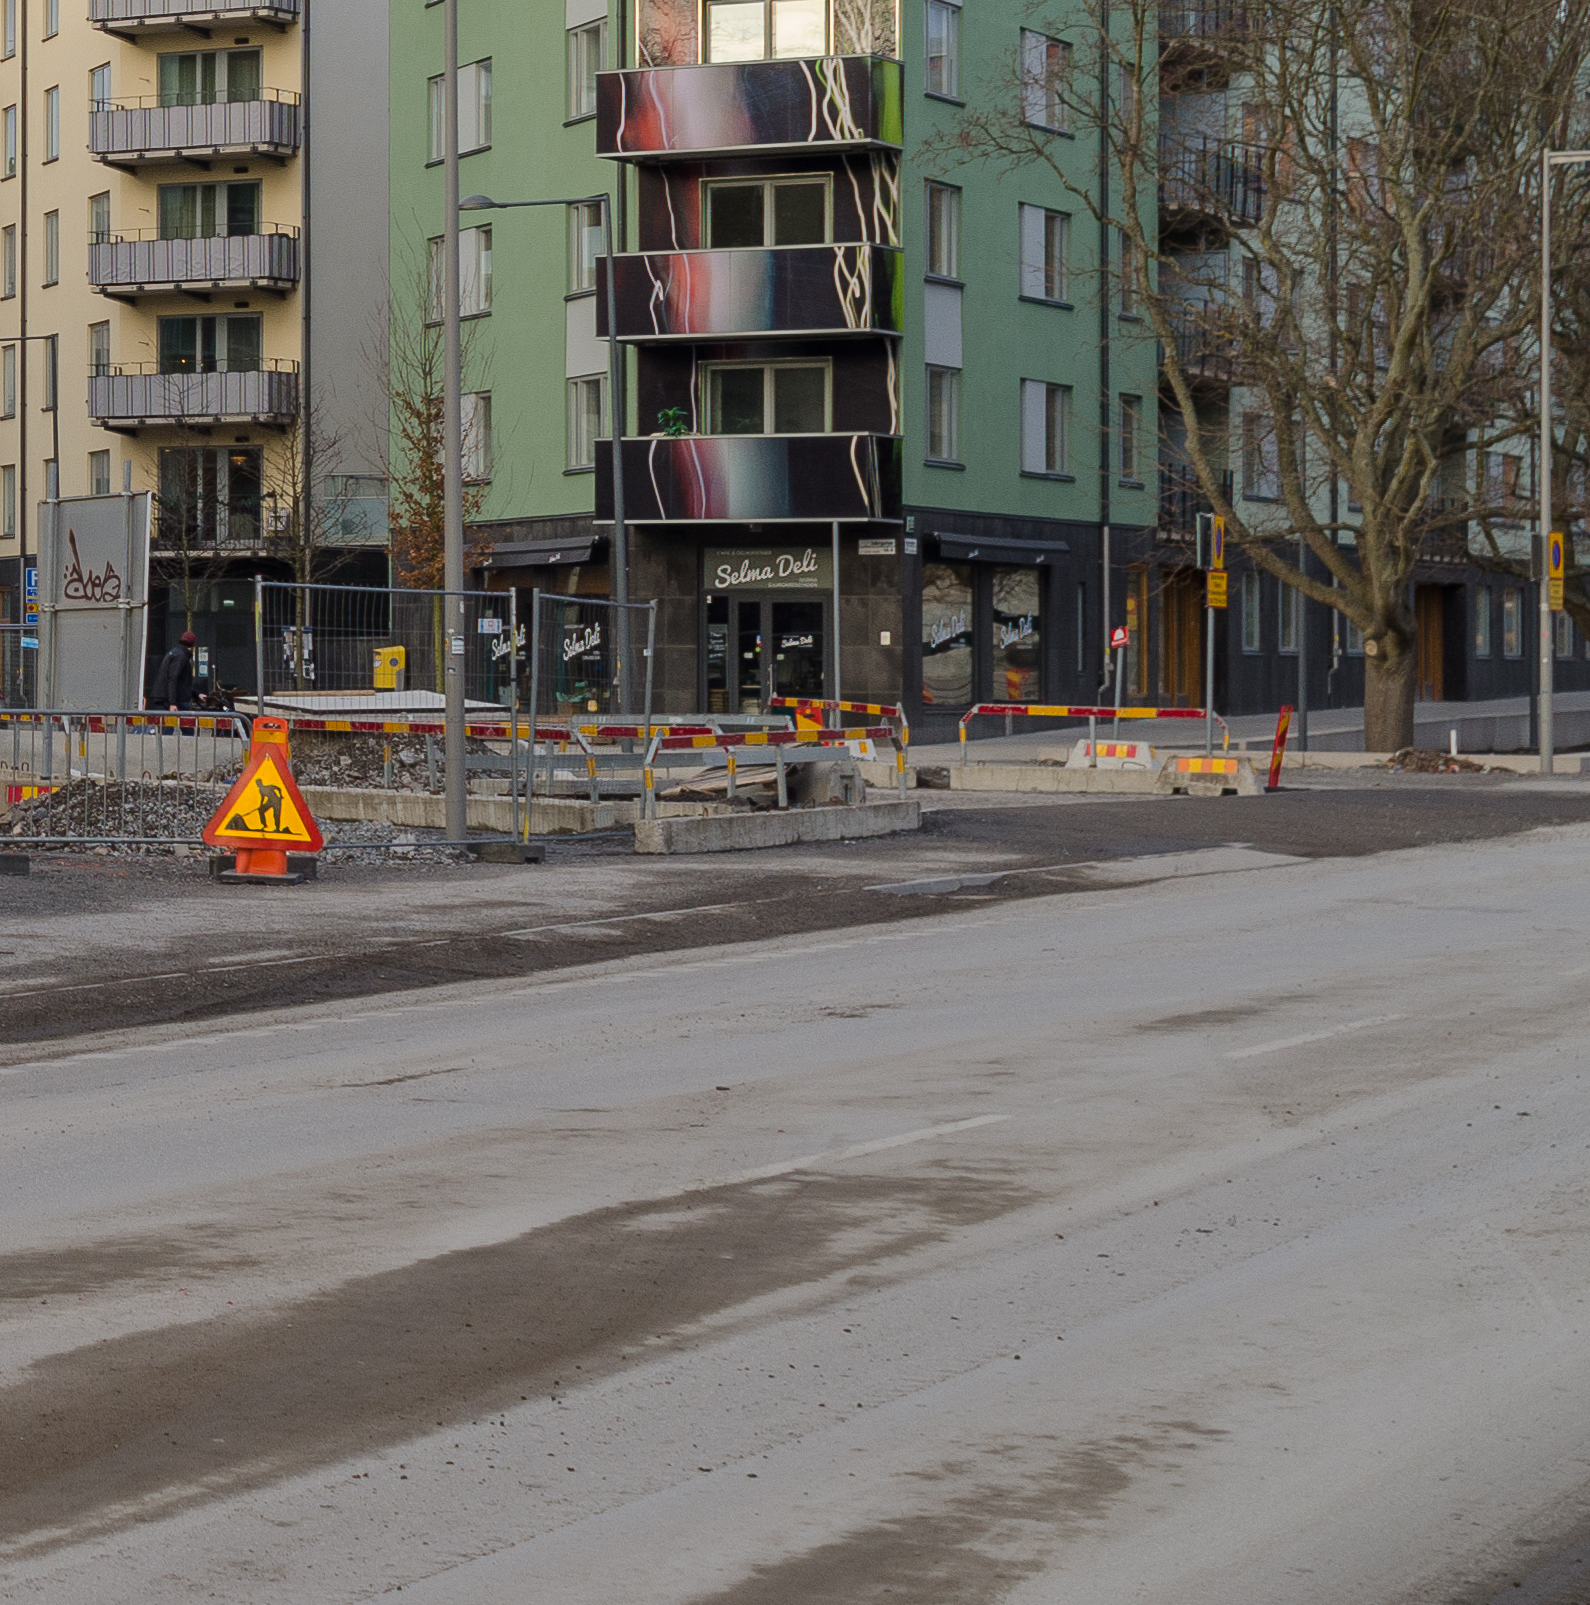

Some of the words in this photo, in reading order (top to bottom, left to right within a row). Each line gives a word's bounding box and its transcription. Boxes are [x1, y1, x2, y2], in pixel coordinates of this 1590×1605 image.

[714, 558, 775, 588] Selma
[776, 548, 818, 577] Deli
[563, 633, 584, 661] Selma
[585, 622, 601, 650] Deli
